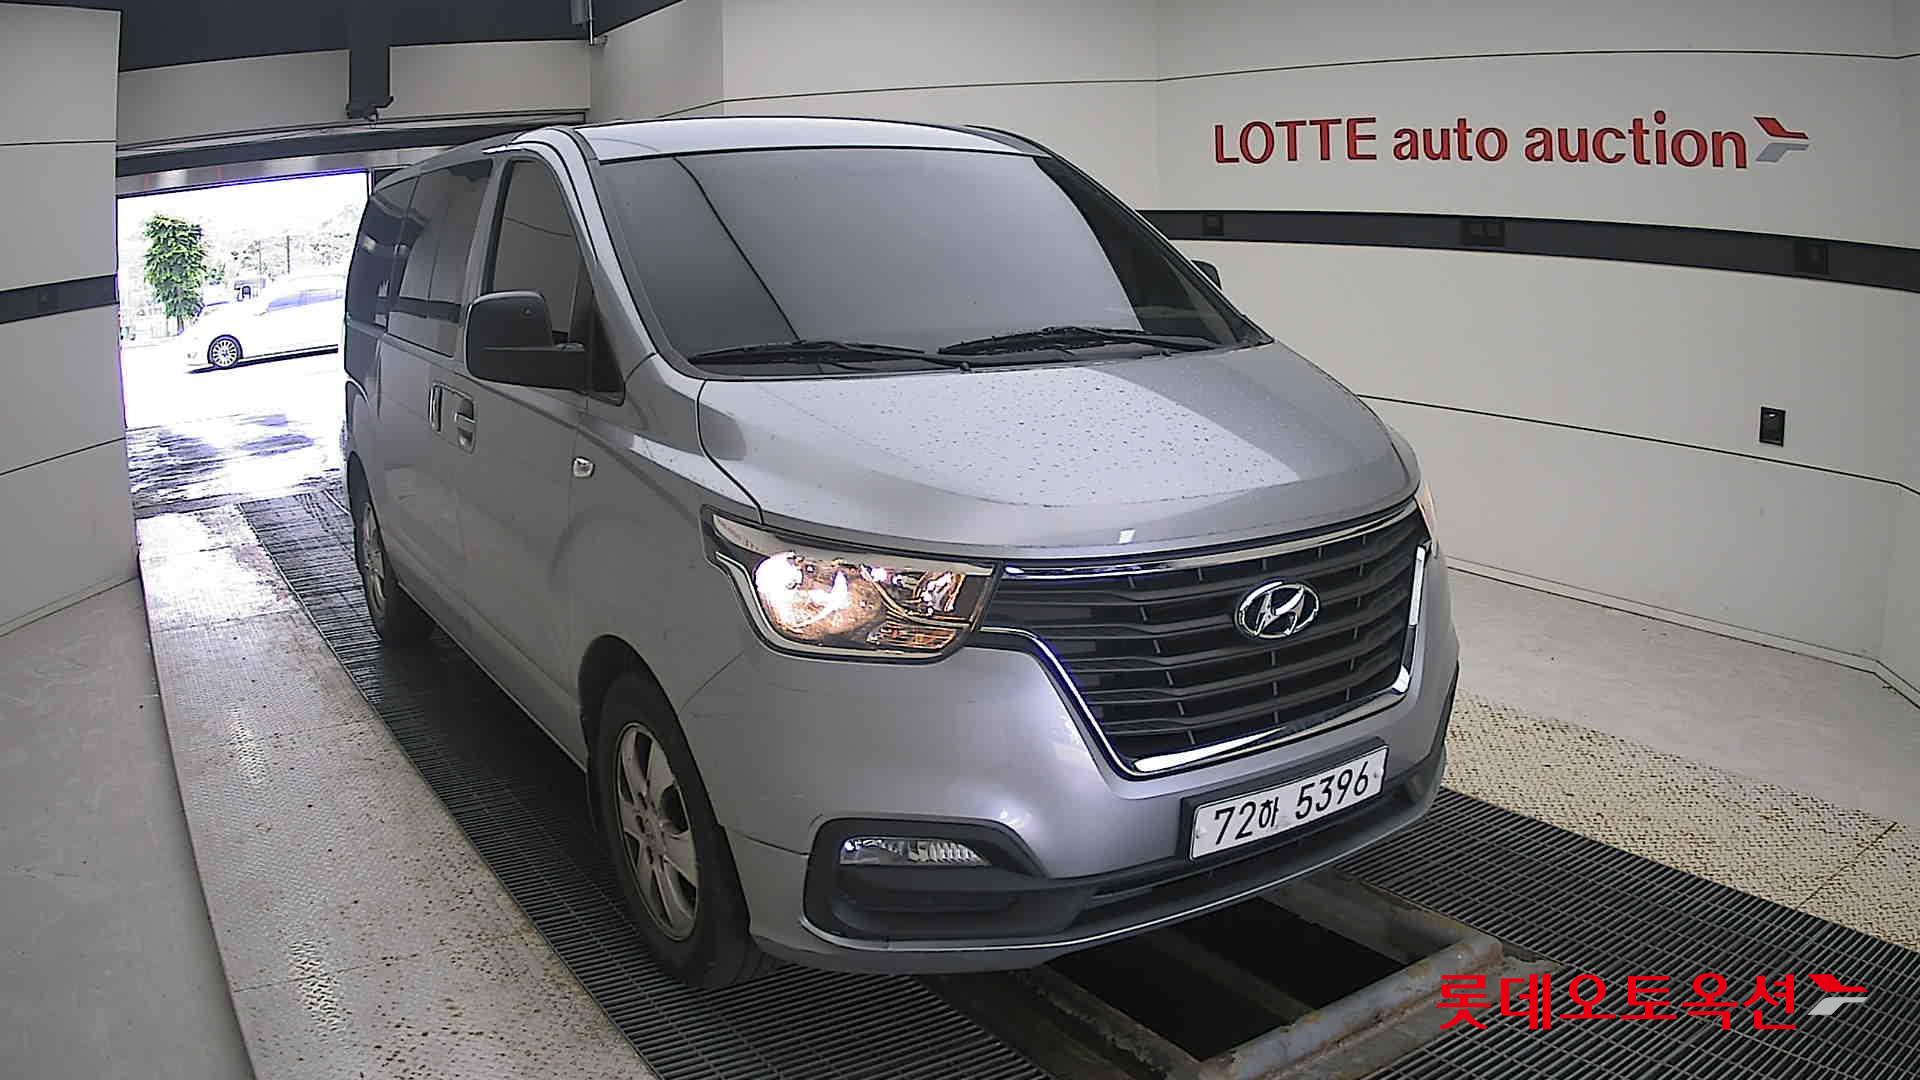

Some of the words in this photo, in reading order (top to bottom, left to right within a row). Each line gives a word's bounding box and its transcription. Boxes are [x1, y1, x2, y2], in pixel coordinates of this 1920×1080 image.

[1214, 117, 1377, 164] LOTTE
[1393, 117, 1508, 162] auto
[1524, 110, 1748, 169] auction
[1214, 797, 1279, 845] 72하
[1295, 761, 1369, 820] 5396
